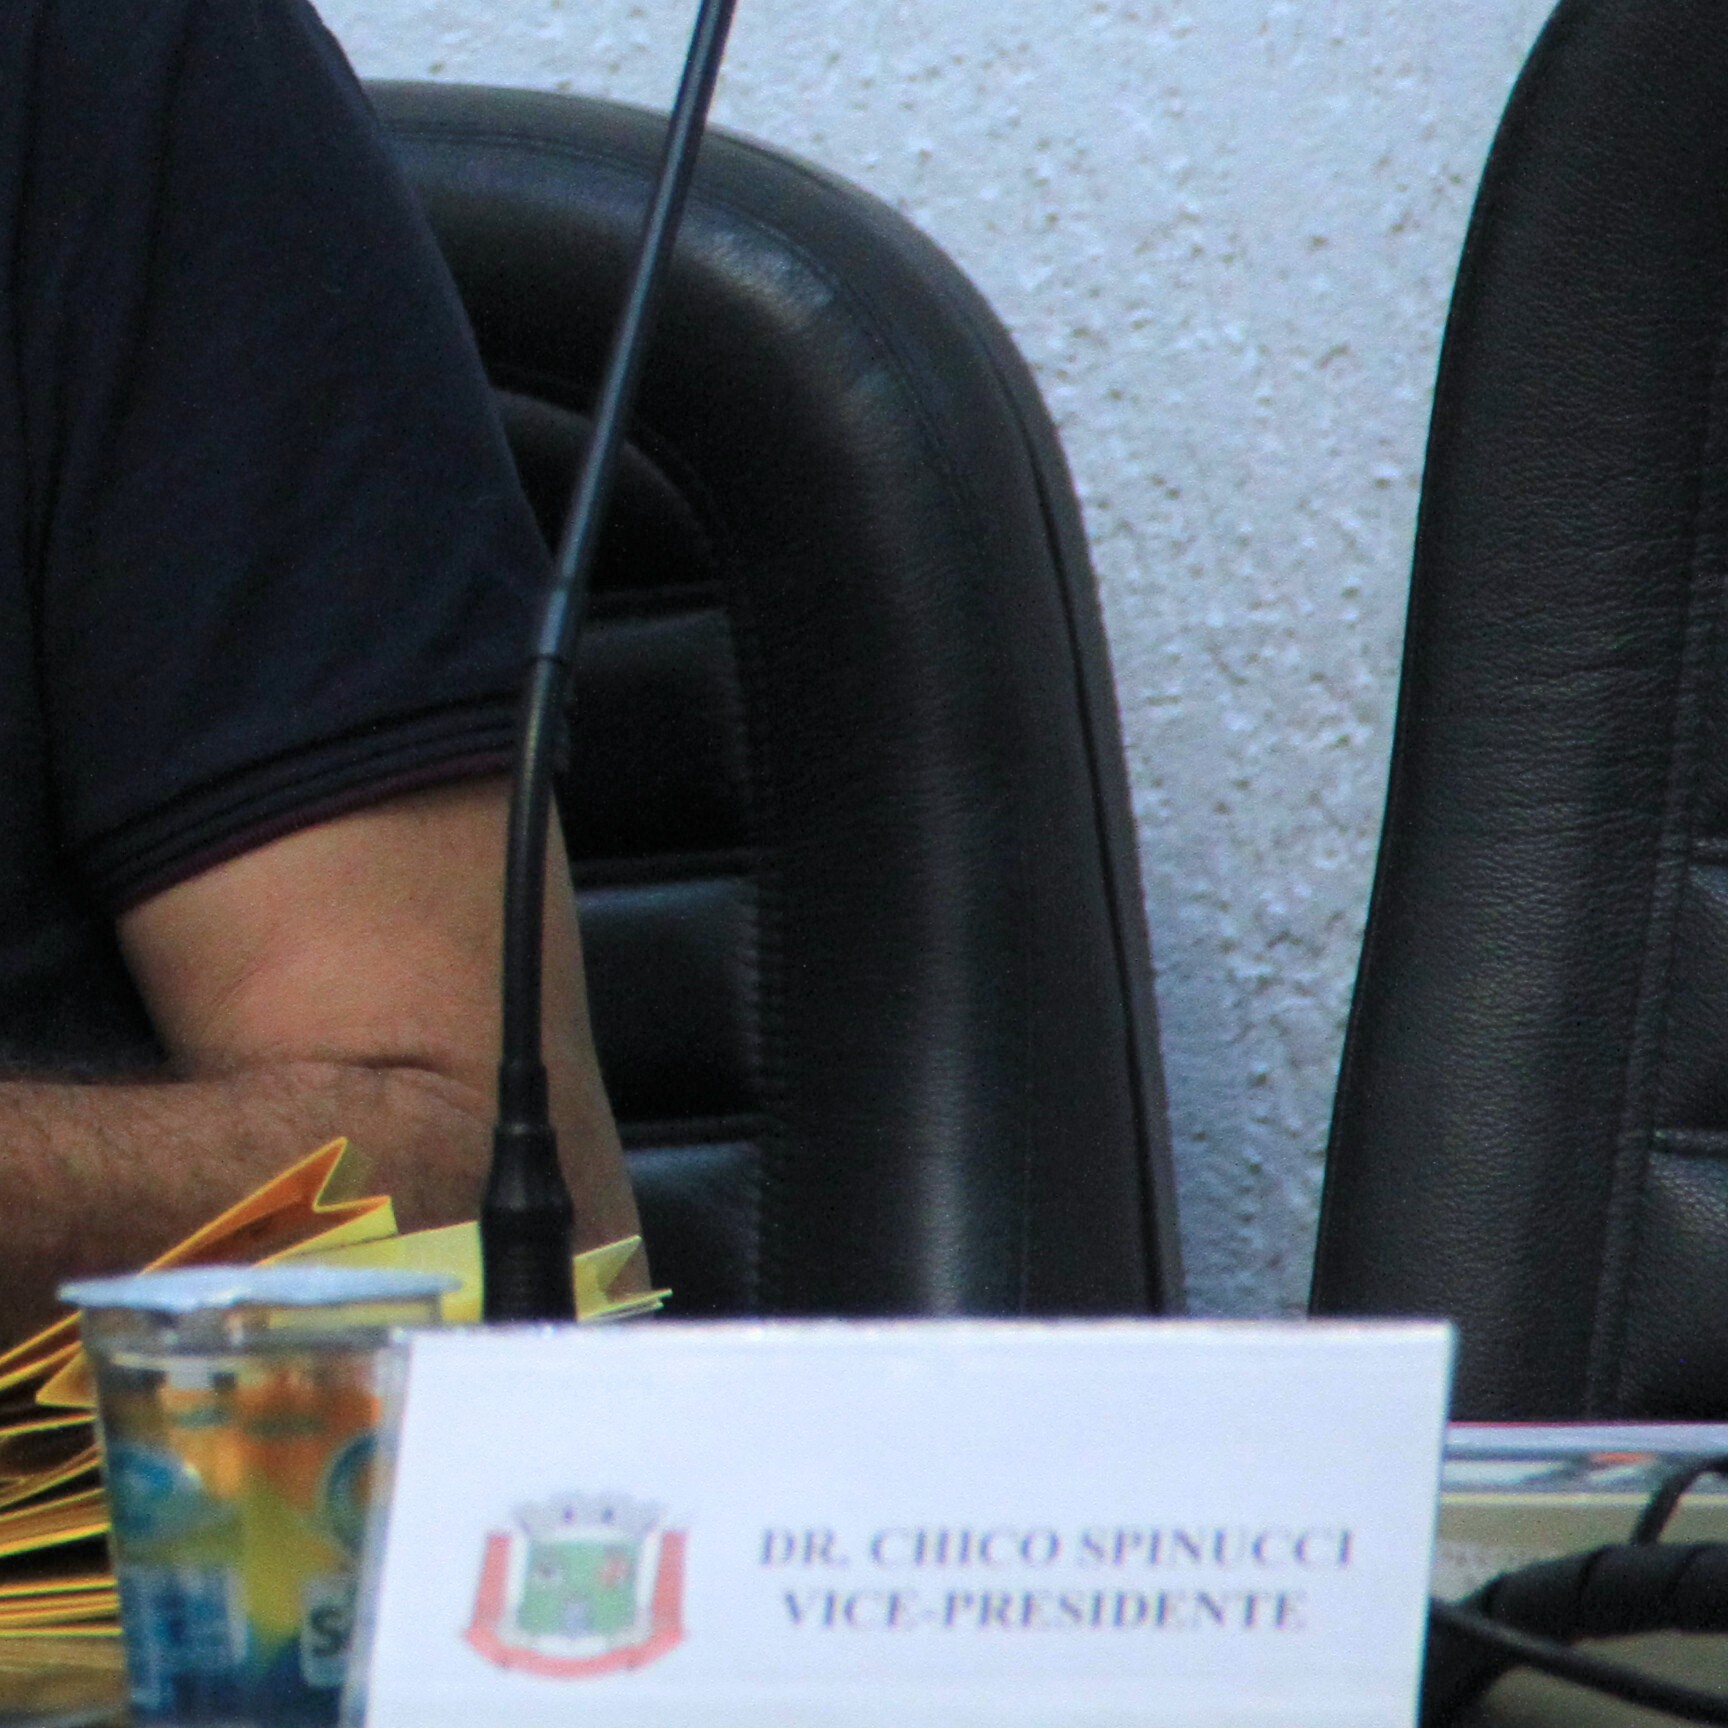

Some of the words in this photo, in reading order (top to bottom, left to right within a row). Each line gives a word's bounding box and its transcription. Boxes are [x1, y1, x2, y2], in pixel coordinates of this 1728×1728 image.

[759, 1526, 849, 1567] DR.
[869, 1526, 1063, 1568] CHICO
[1078, 1526, 1354, 1568] SPINUCCI
[783, 1588, 1308, 1630] VICE-PRESIDENTE
